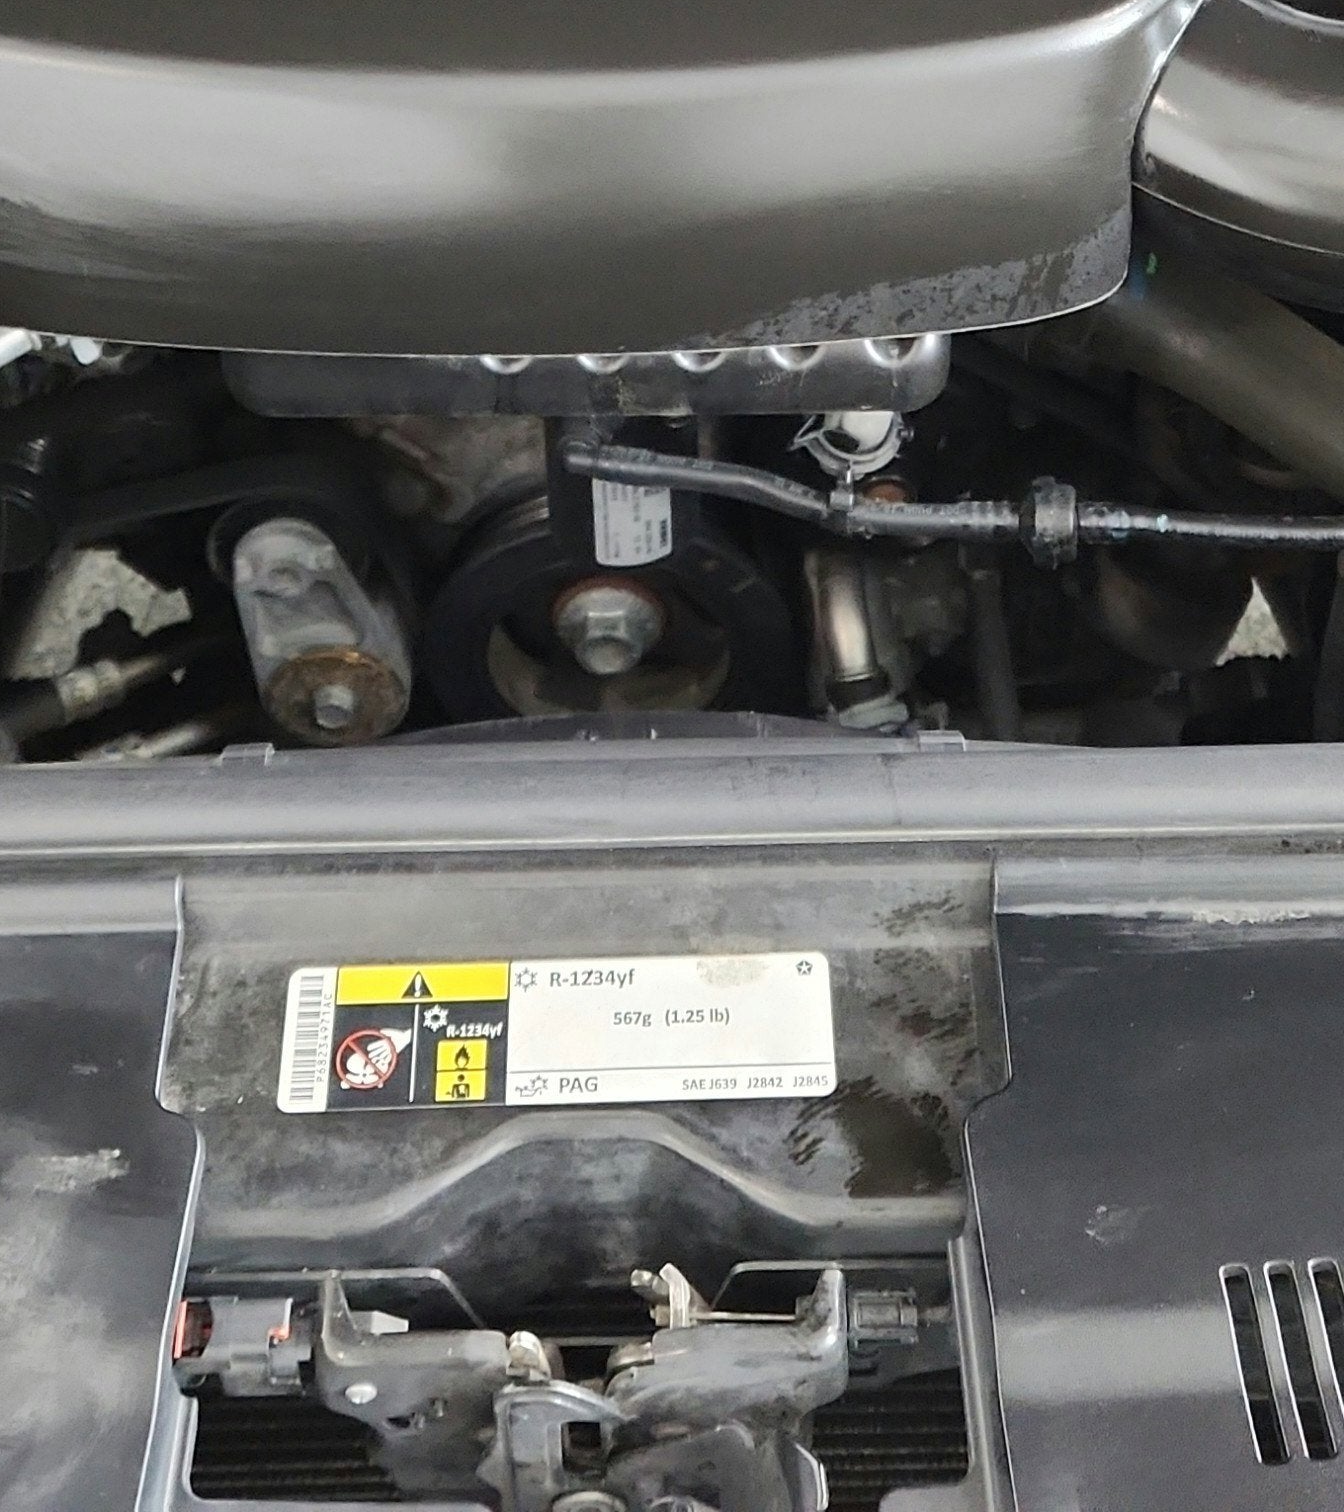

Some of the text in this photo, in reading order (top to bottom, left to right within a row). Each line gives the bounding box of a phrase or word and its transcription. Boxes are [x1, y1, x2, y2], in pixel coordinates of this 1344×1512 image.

[549, 968, 635, 988] R-1234yf
[613, 1007, 730, 1027] 567g (1.25 lb)
[446, 1021, 503, 1039] R-1234yf
[559, 1075, 829, 1094] PAG SAE J639 J2842 J2845
